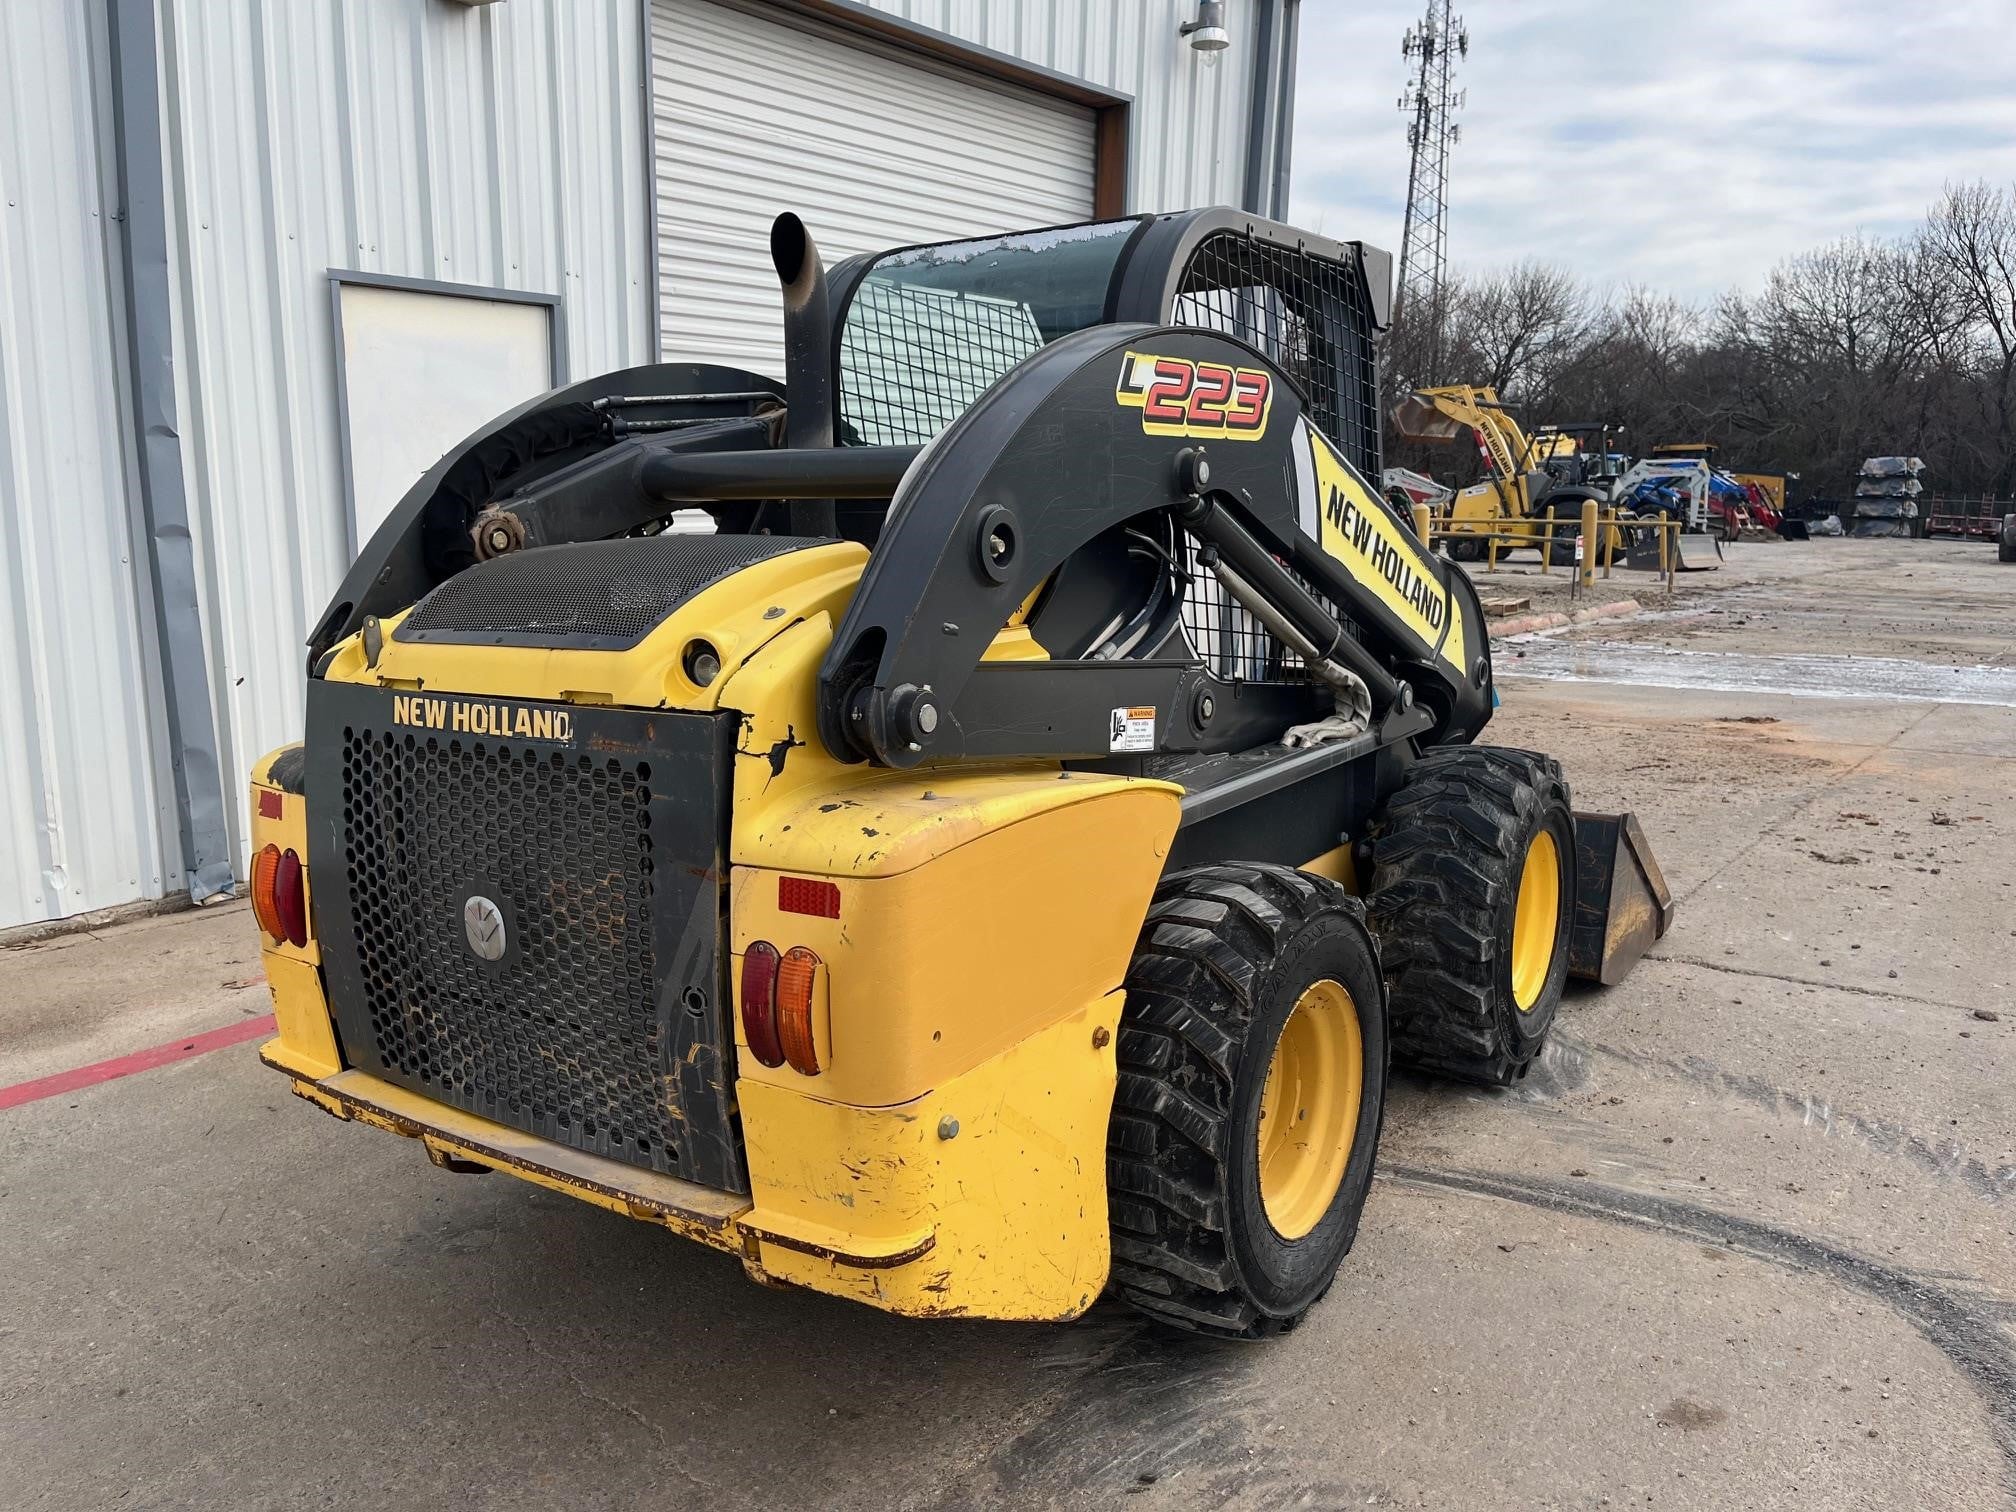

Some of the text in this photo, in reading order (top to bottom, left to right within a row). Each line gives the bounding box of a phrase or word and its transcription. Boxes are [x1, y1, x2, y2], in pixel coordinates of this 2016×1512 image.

[1118, 355, 1271, 433] L223
[1480, 421, 1512, 474] NEW HOLLAND
[1326, 484, 1443, 631] NEW HOLLAND
[393, 695, 570, 740] NEW HOLLAND
